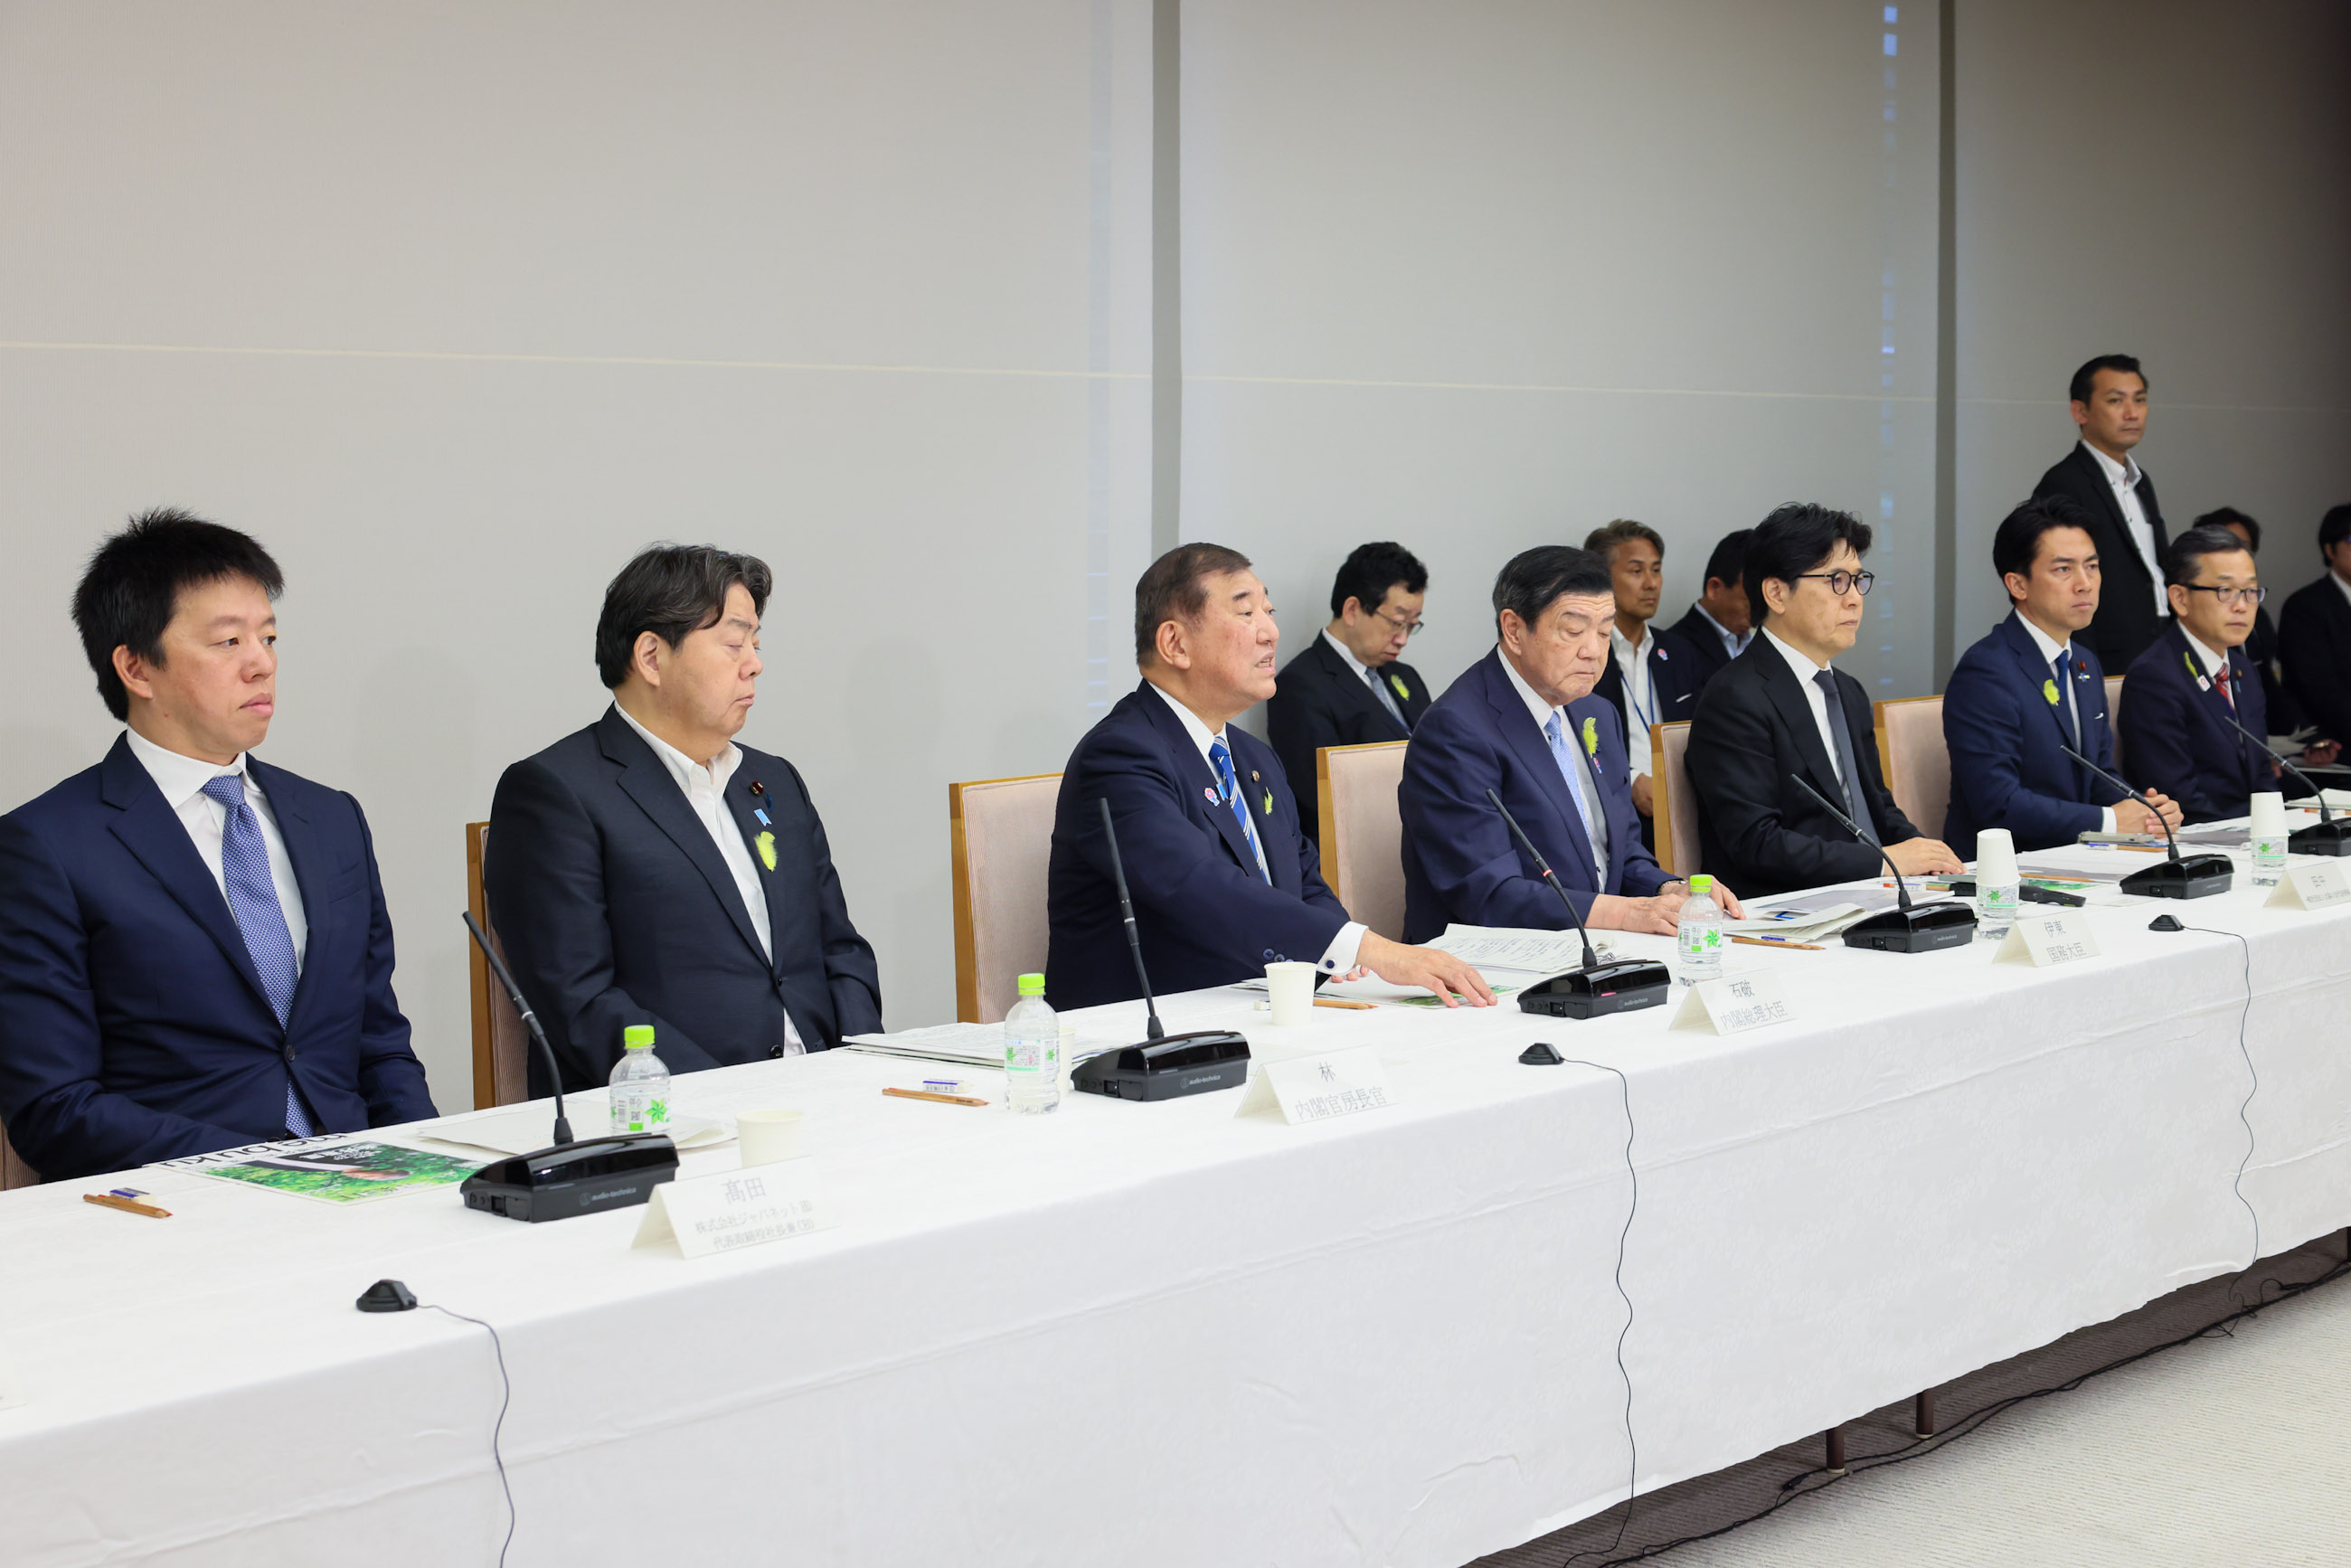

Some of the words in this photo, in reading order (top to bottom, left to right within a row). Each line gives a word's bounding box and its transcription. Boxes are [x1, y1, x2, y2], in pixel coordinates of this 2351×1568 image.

[2044, 920, 2066, 938] 伊東
[2046, 942, 2086, 962] 国務大臣
[1729, 979, 1755, 998] 石破
[1720, 1001, 1789, 1029] 内閣総理大臣
[1189, 1075, 1221, 1085] audio-technica
[1318, 1062, 1336, 1082] 林
[1295, 1086, 1387, 1120] 内閣官房長官
[591, 1187, 637, 1202] audio-technica
